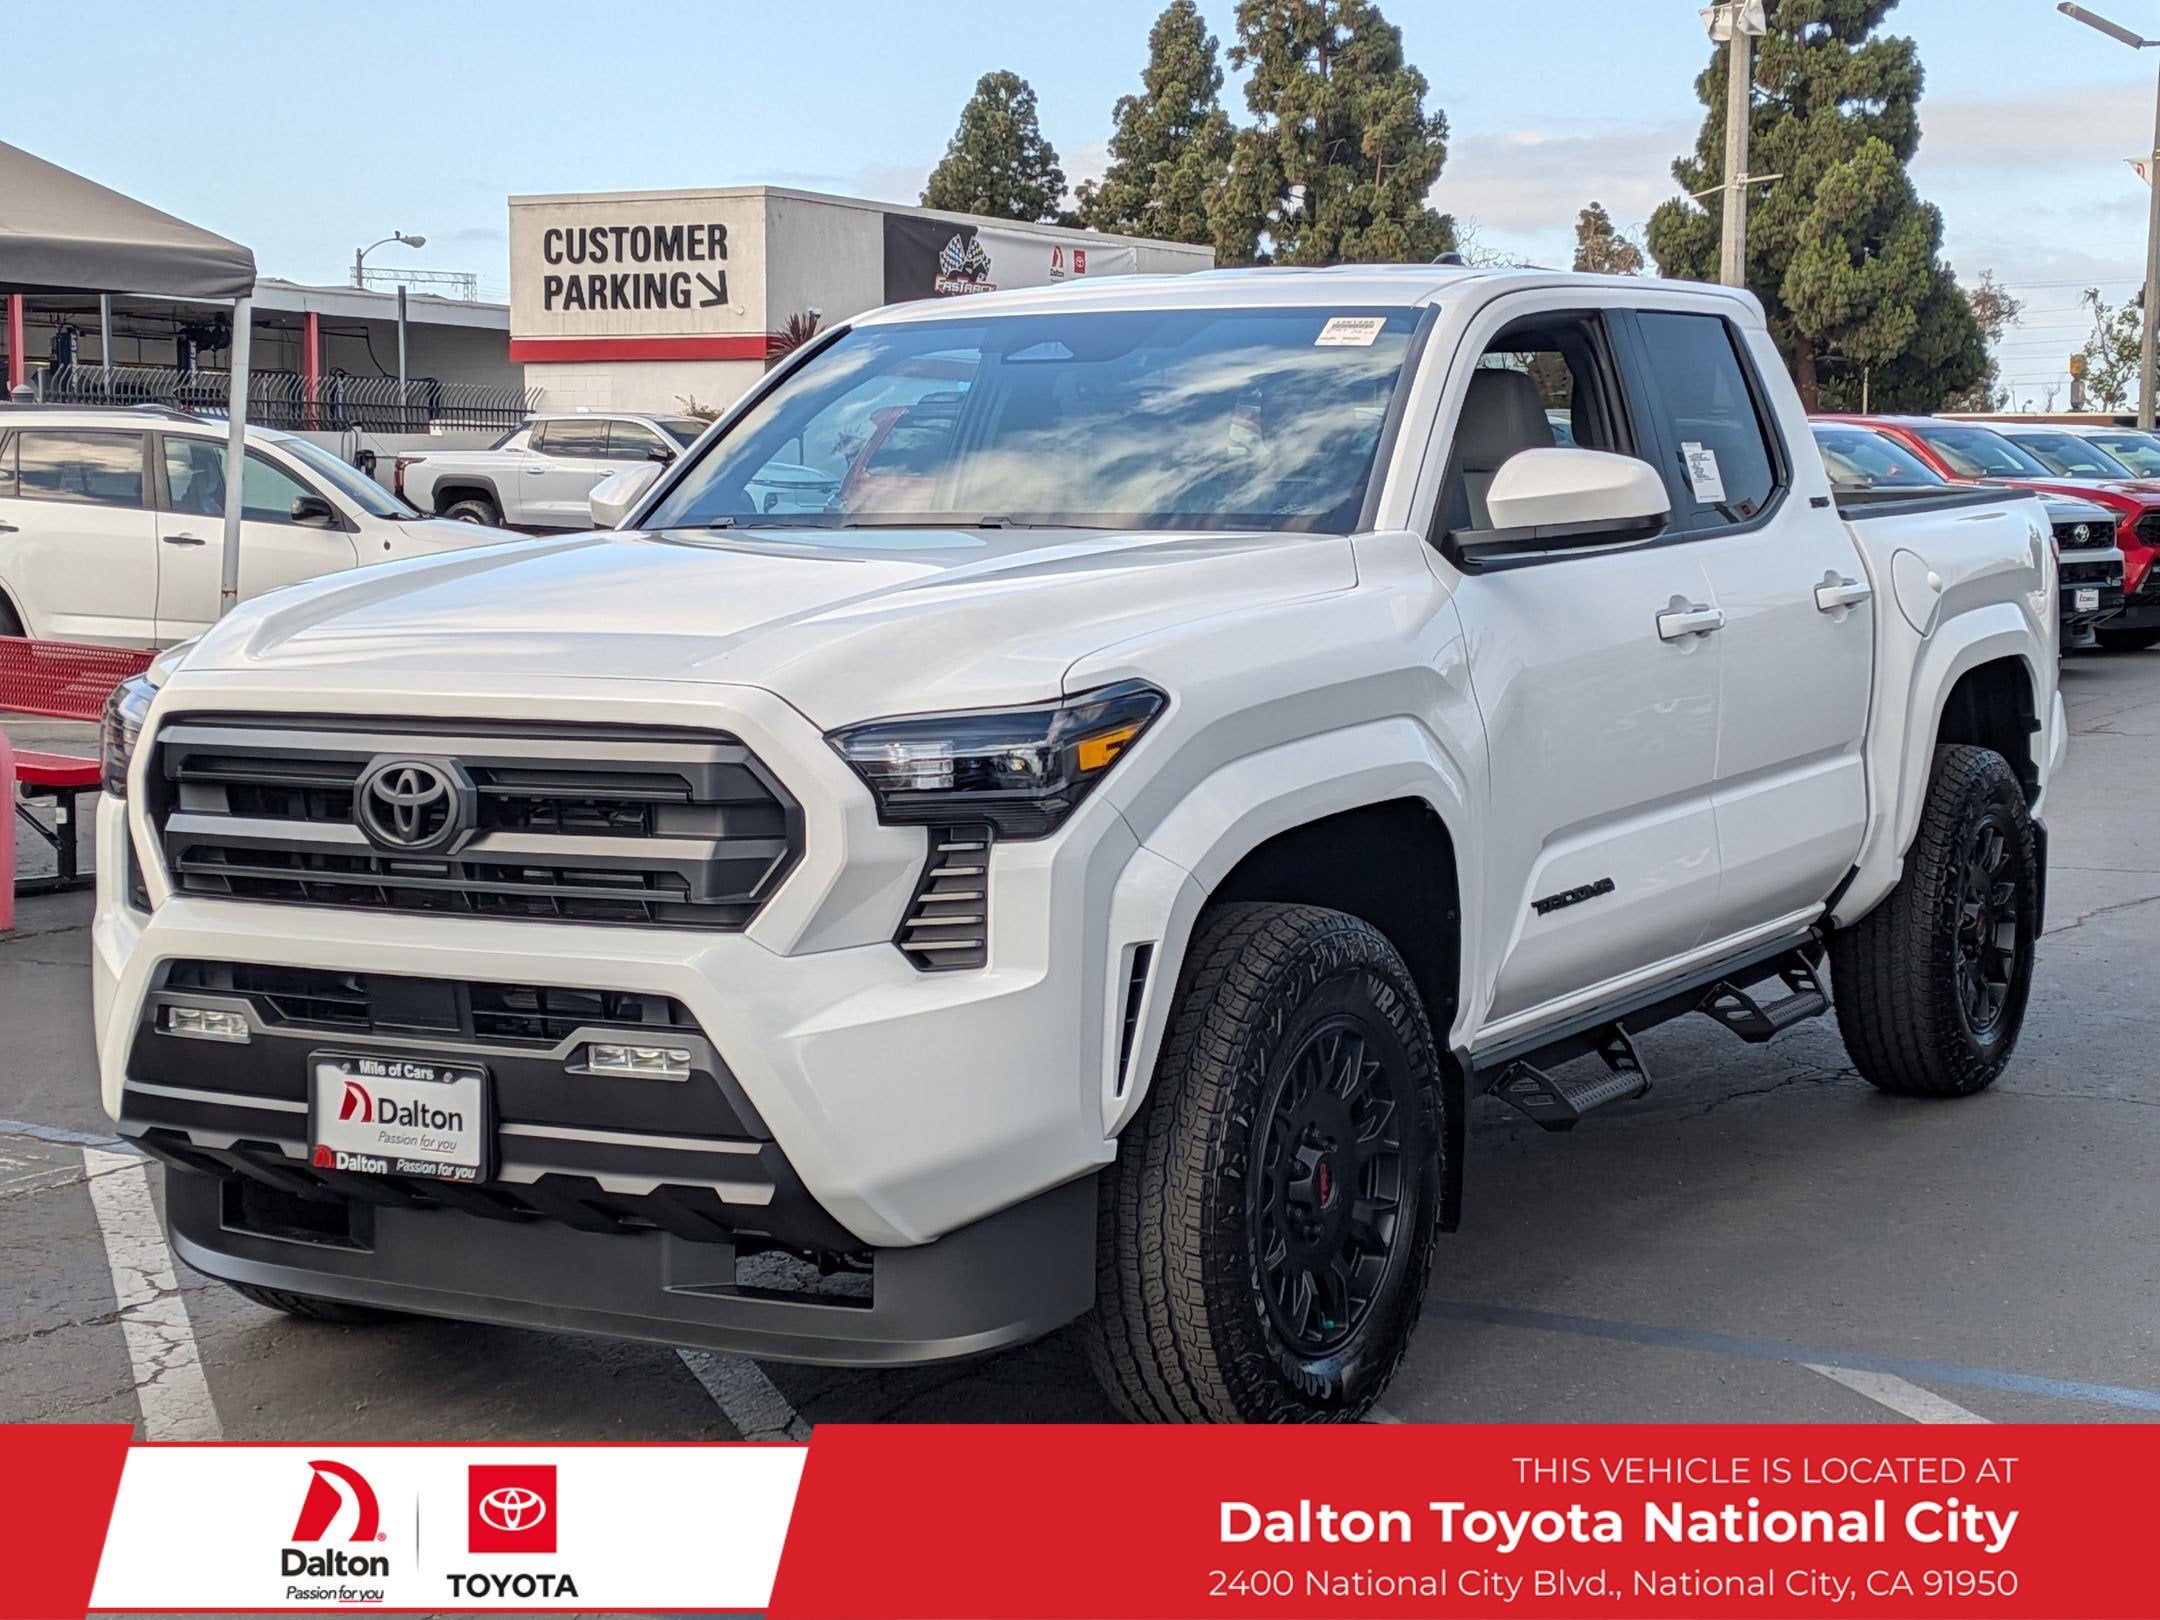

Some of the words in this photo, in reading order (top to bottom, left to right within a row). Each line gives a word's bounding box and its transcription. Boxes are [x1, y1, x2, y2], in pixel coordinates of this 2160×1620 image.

[543, 223, 728, 265] CUSTOMER
[543, 271, 692, 311] PARKING
[359, 1060, 386, 1075] Mile
[388, 1064, 402, 1077] of
[404, 1064, 435, 1080] Cars
[378, 1097, 464, 1132] Dalton
[378, 1131, 417, 1146] Passion
[420, 1134, 435, 1149] for
[436, 1139, 458, 1152] you
[335, 1153, 388, 1175] Dalton
[396, 1158, 436, 1175] Passion
[437, 1163, 455, 1177] for
[454, 1167, 477, 1180] you
